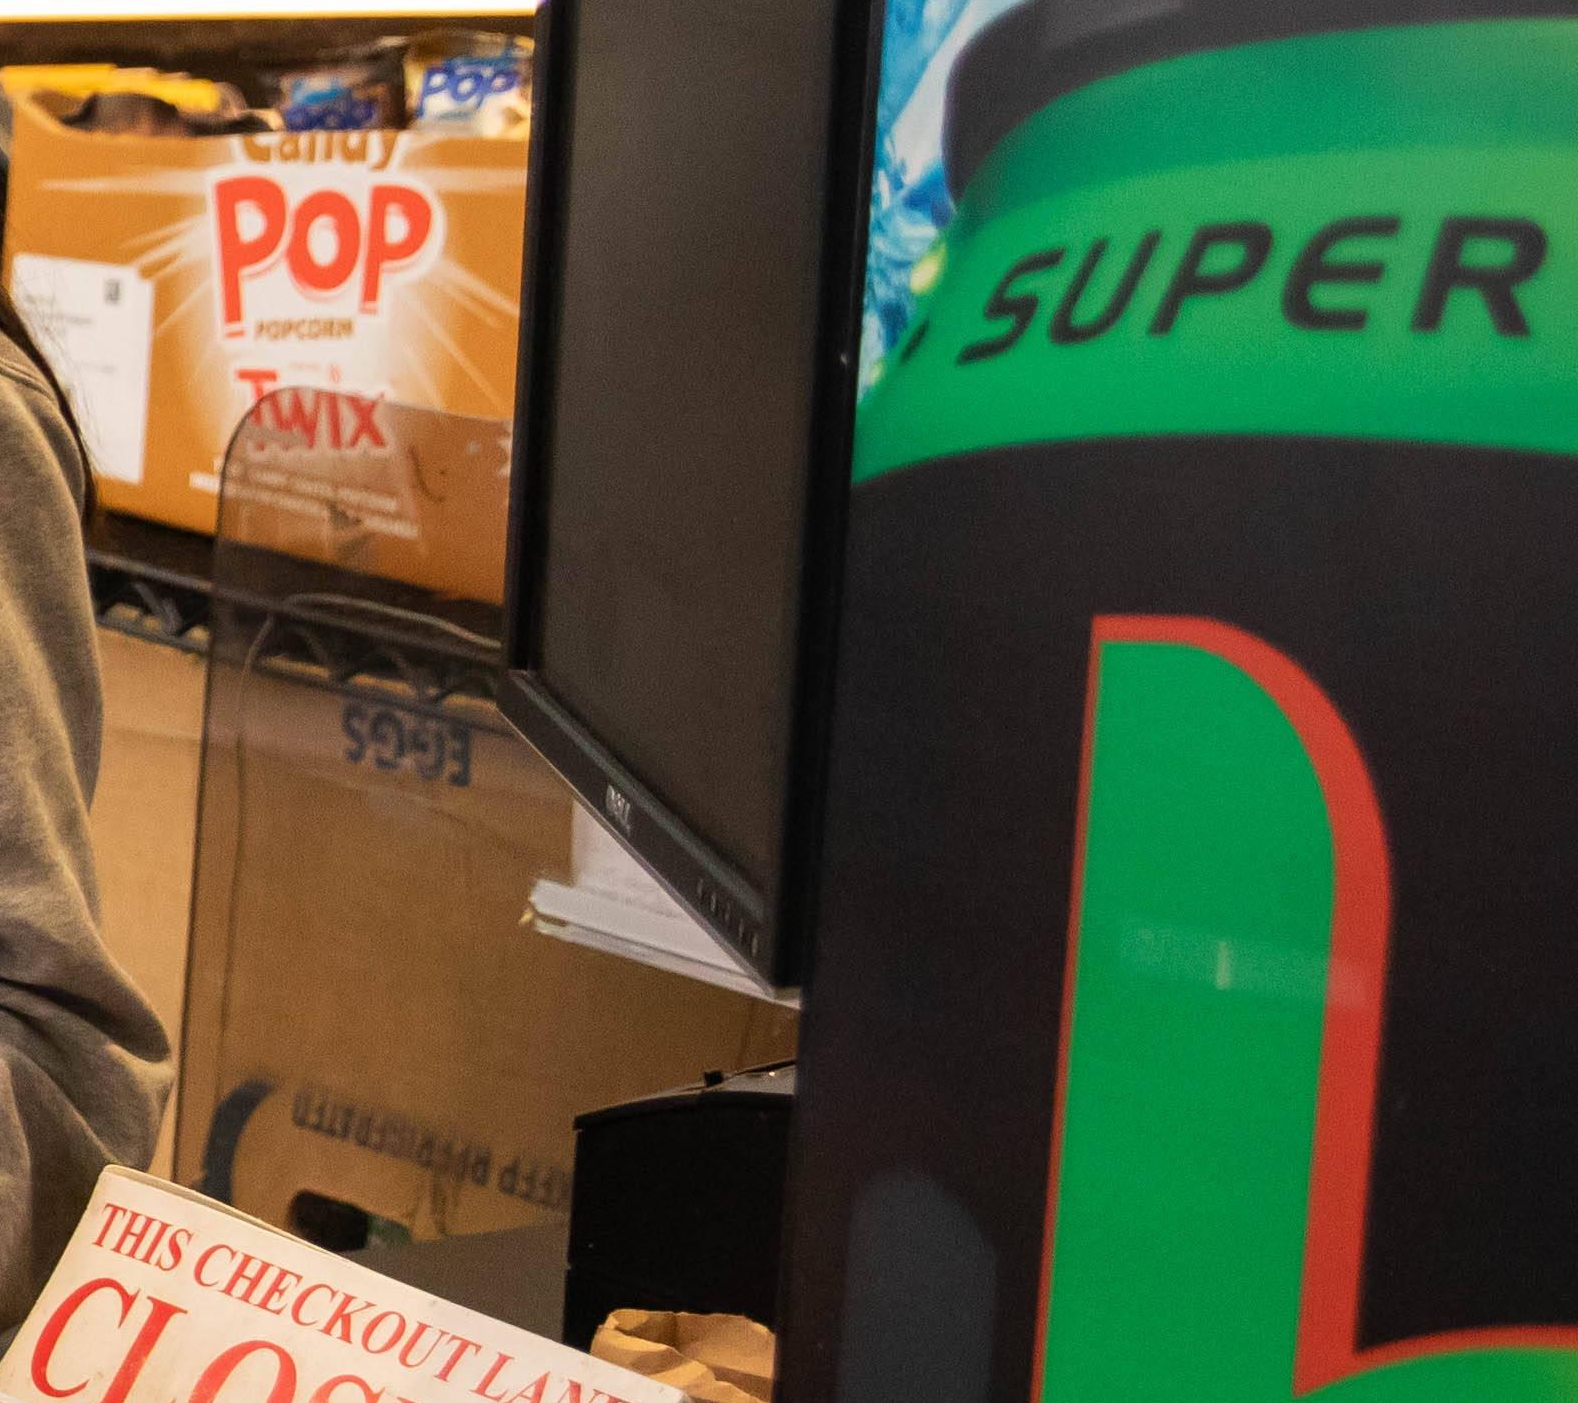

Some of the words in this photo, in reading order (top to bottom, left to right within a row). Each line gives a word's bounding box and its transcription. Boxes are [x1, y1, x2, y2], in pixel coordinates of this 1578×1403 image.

[213, 175, 434, 337] POP
[254, 319, 353, 343] POPCORN
[955, 214, 1549, 366] SUPER
[343, 702, 472, 787] EGGS
[92, 1202, 194, 1273] THIS
[191, 1243, 481, 1382] CHECKOUT
